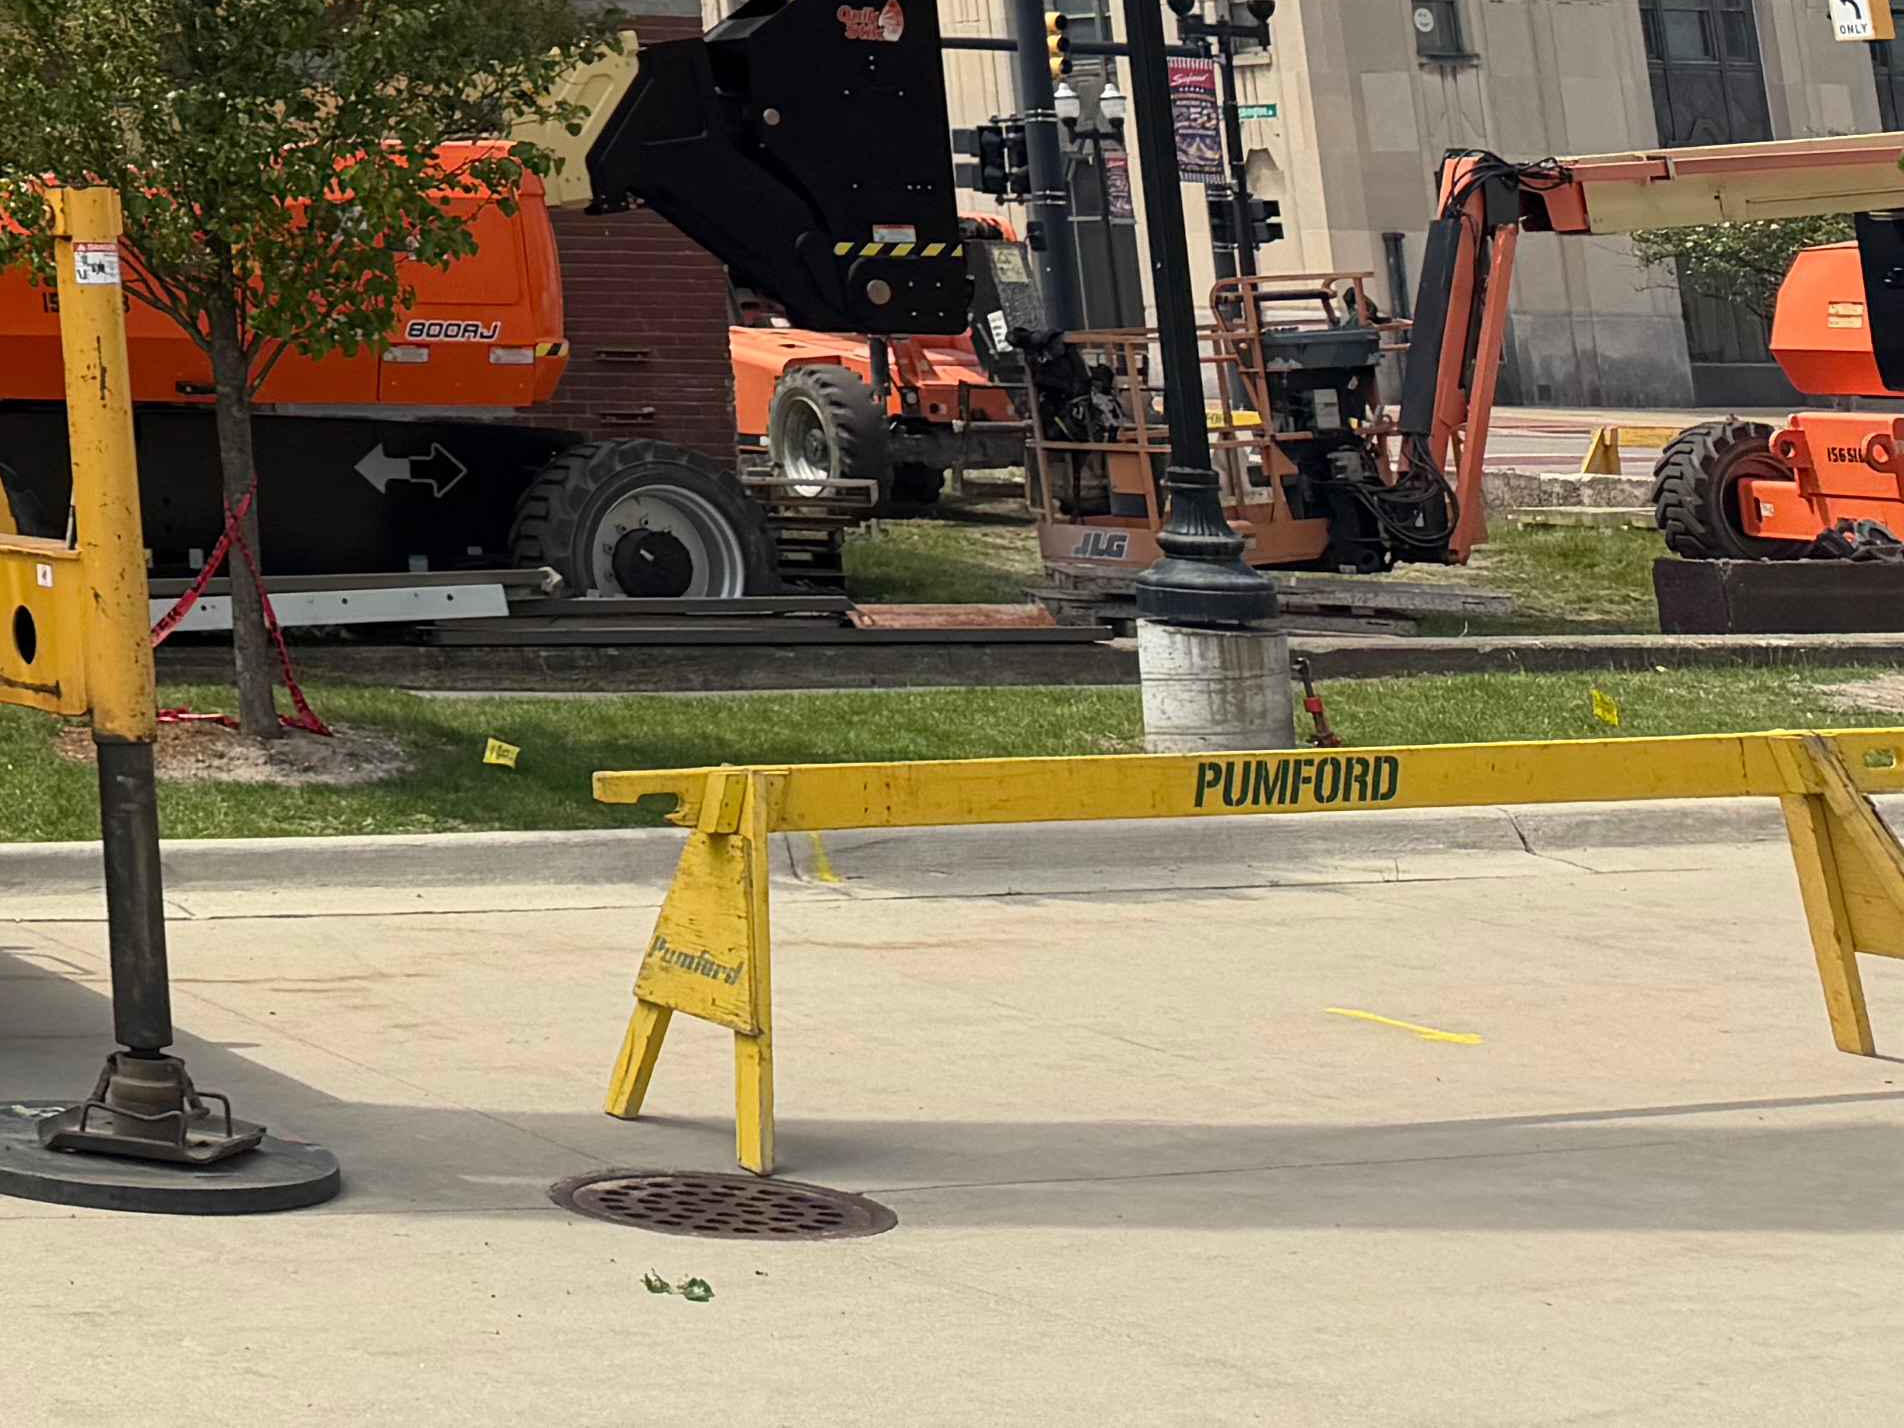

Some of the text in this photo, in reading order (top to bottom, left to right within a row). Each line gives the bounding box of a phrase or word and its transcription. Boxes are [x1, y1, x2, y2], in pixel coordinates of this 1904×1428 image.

[1839, 24, 1867, 34] ONLY
[405, 320, 501, 341] 800AJ
[1072, 532, 1129, 559] JLG
[1194, 755, 1399, 808] PUMFORD
